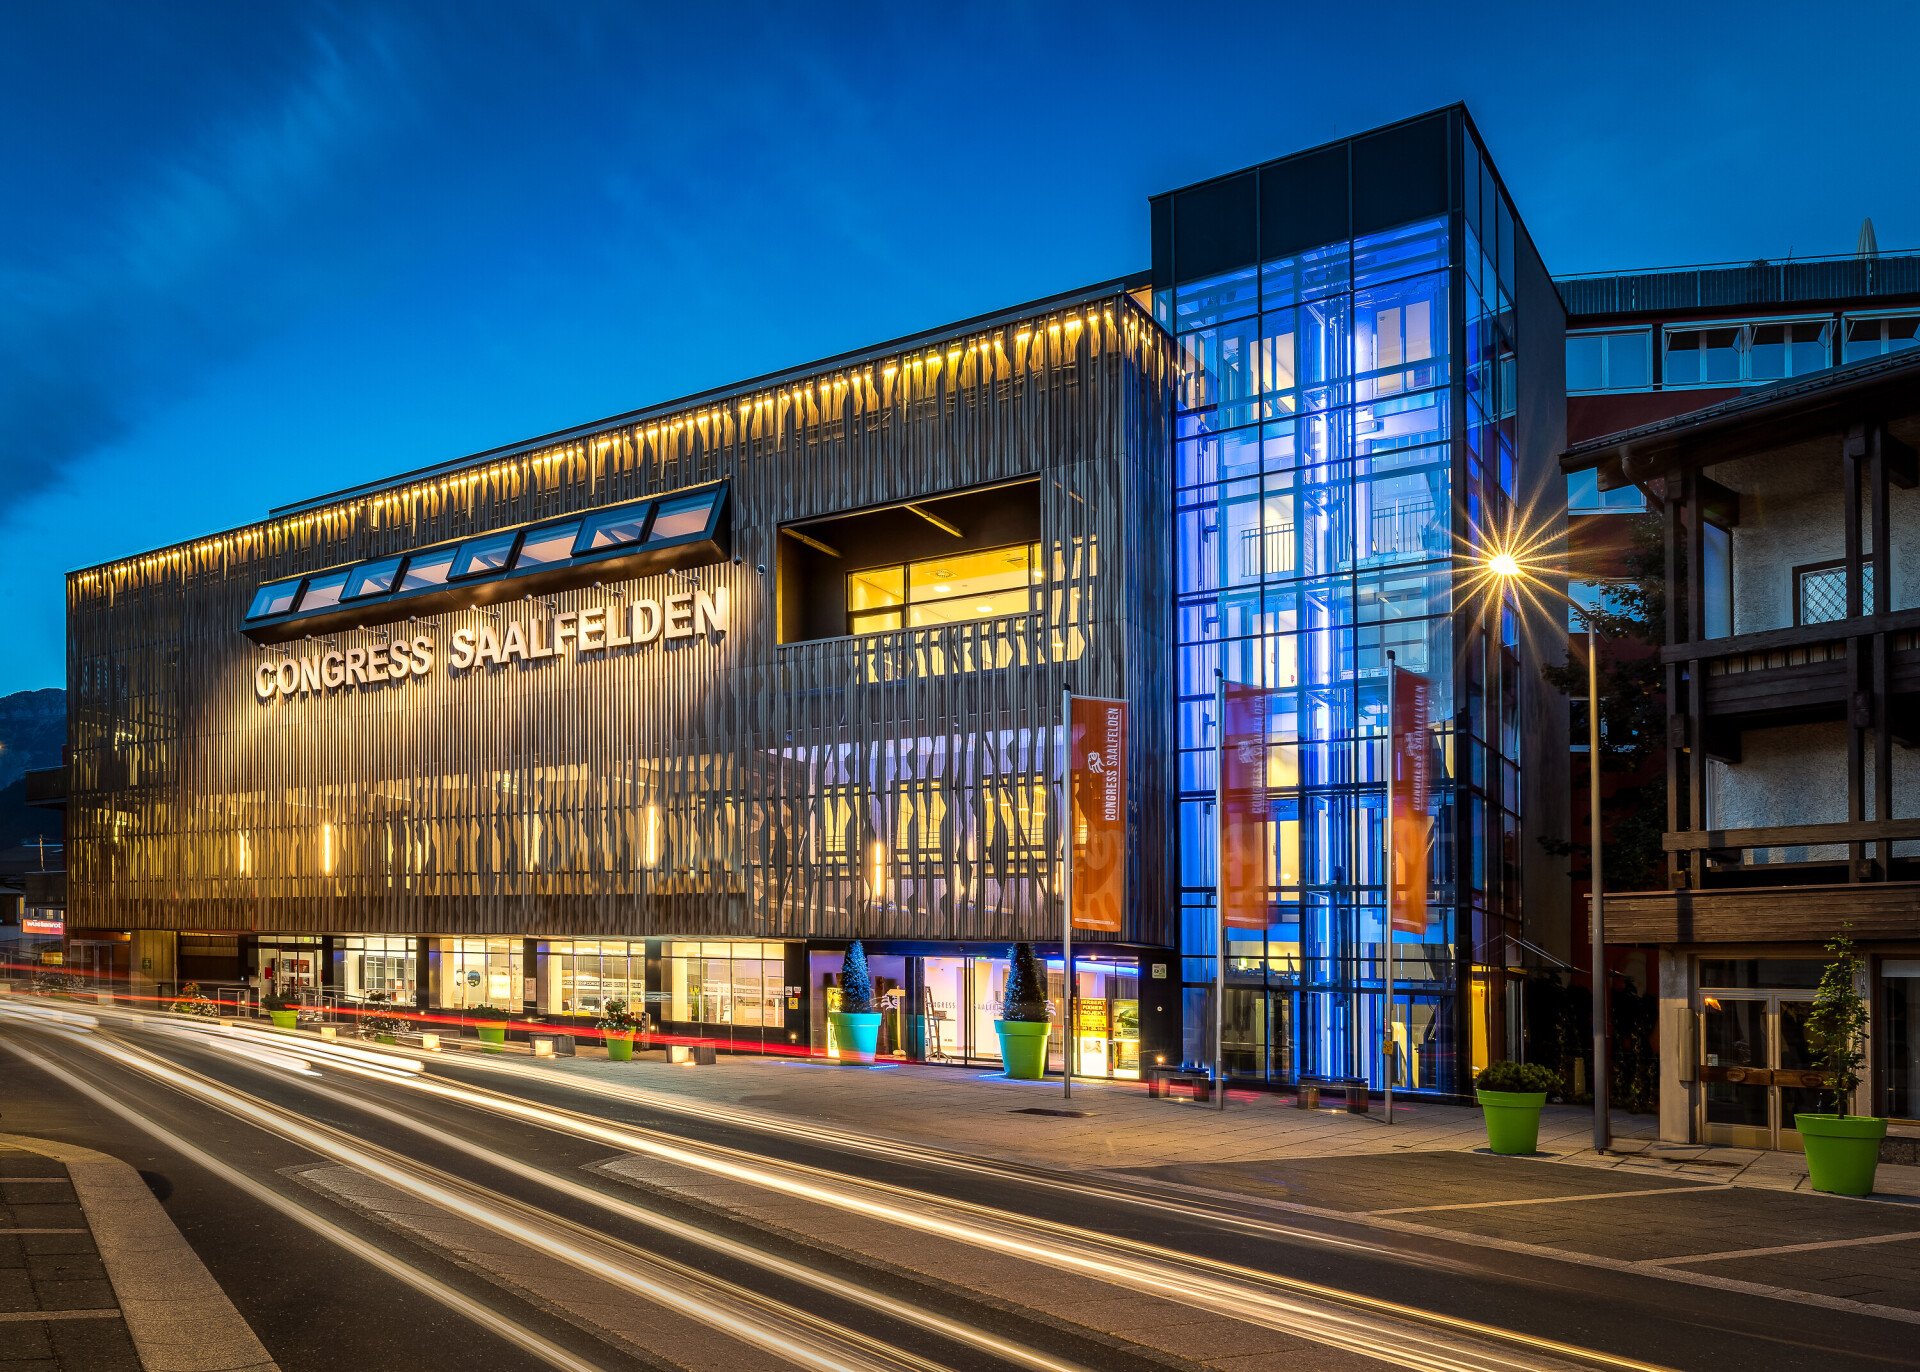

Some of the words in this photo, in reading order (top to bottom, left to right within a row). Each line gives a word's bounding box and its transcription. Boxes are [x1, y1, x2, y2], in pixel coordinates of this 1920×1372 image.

[255, 635, 434, 698] CONGRESS
[450, 586, 728, 669] SAALFELDEN
[1106, 707, 1120, 767] SAALFELDEN
[1104, 769, 1118, 821] CONGRESS
